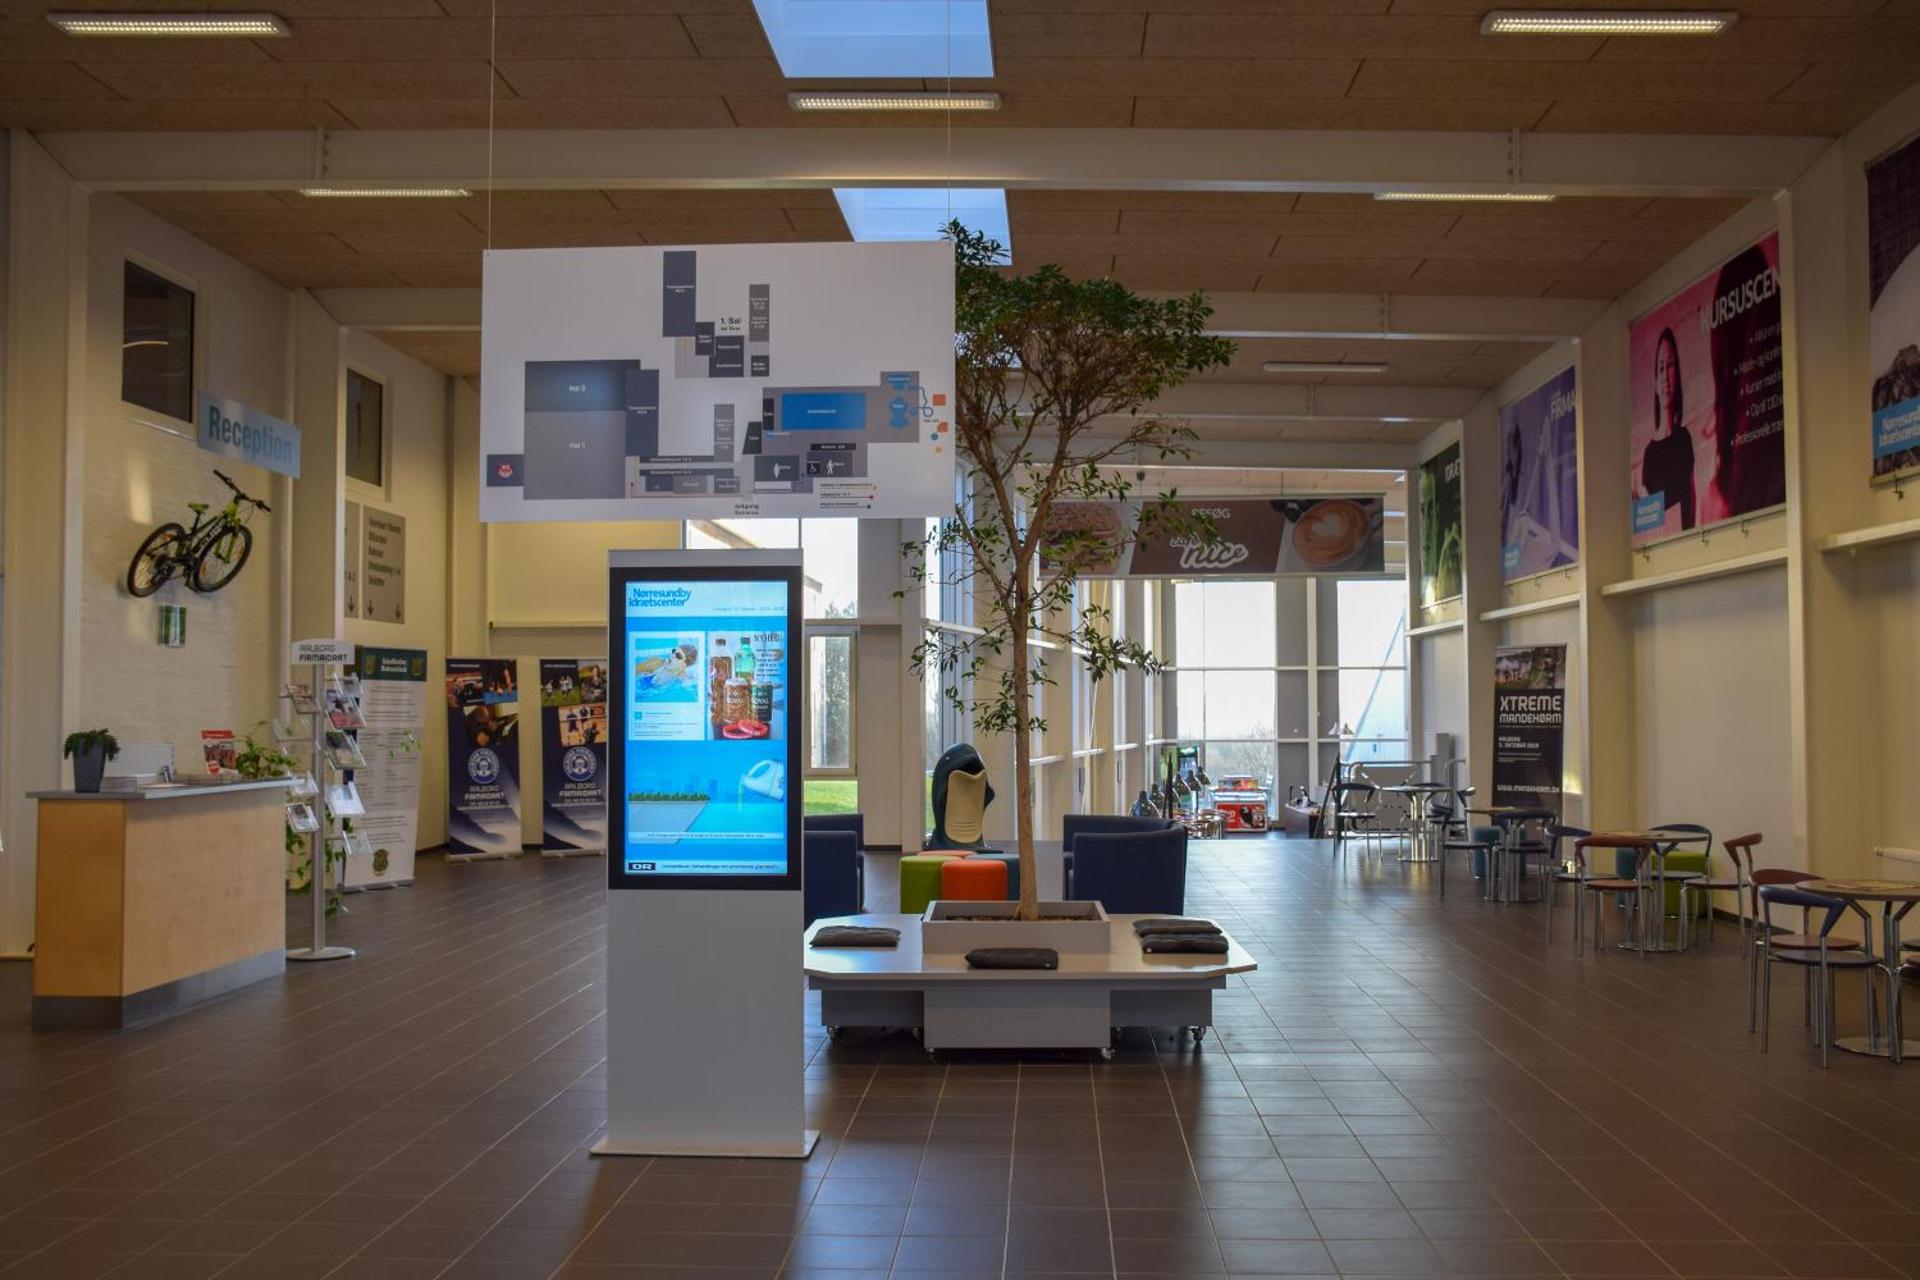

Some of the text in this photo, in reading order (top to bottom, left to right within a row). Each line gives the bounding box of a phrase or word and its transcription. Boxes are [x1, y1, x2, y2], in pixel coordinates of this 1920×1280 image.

[209, 405, 292, 459] Reception
[633, 588, 692, 601] Nørresundby
[1500, 695, 1561, 712] XTREME
